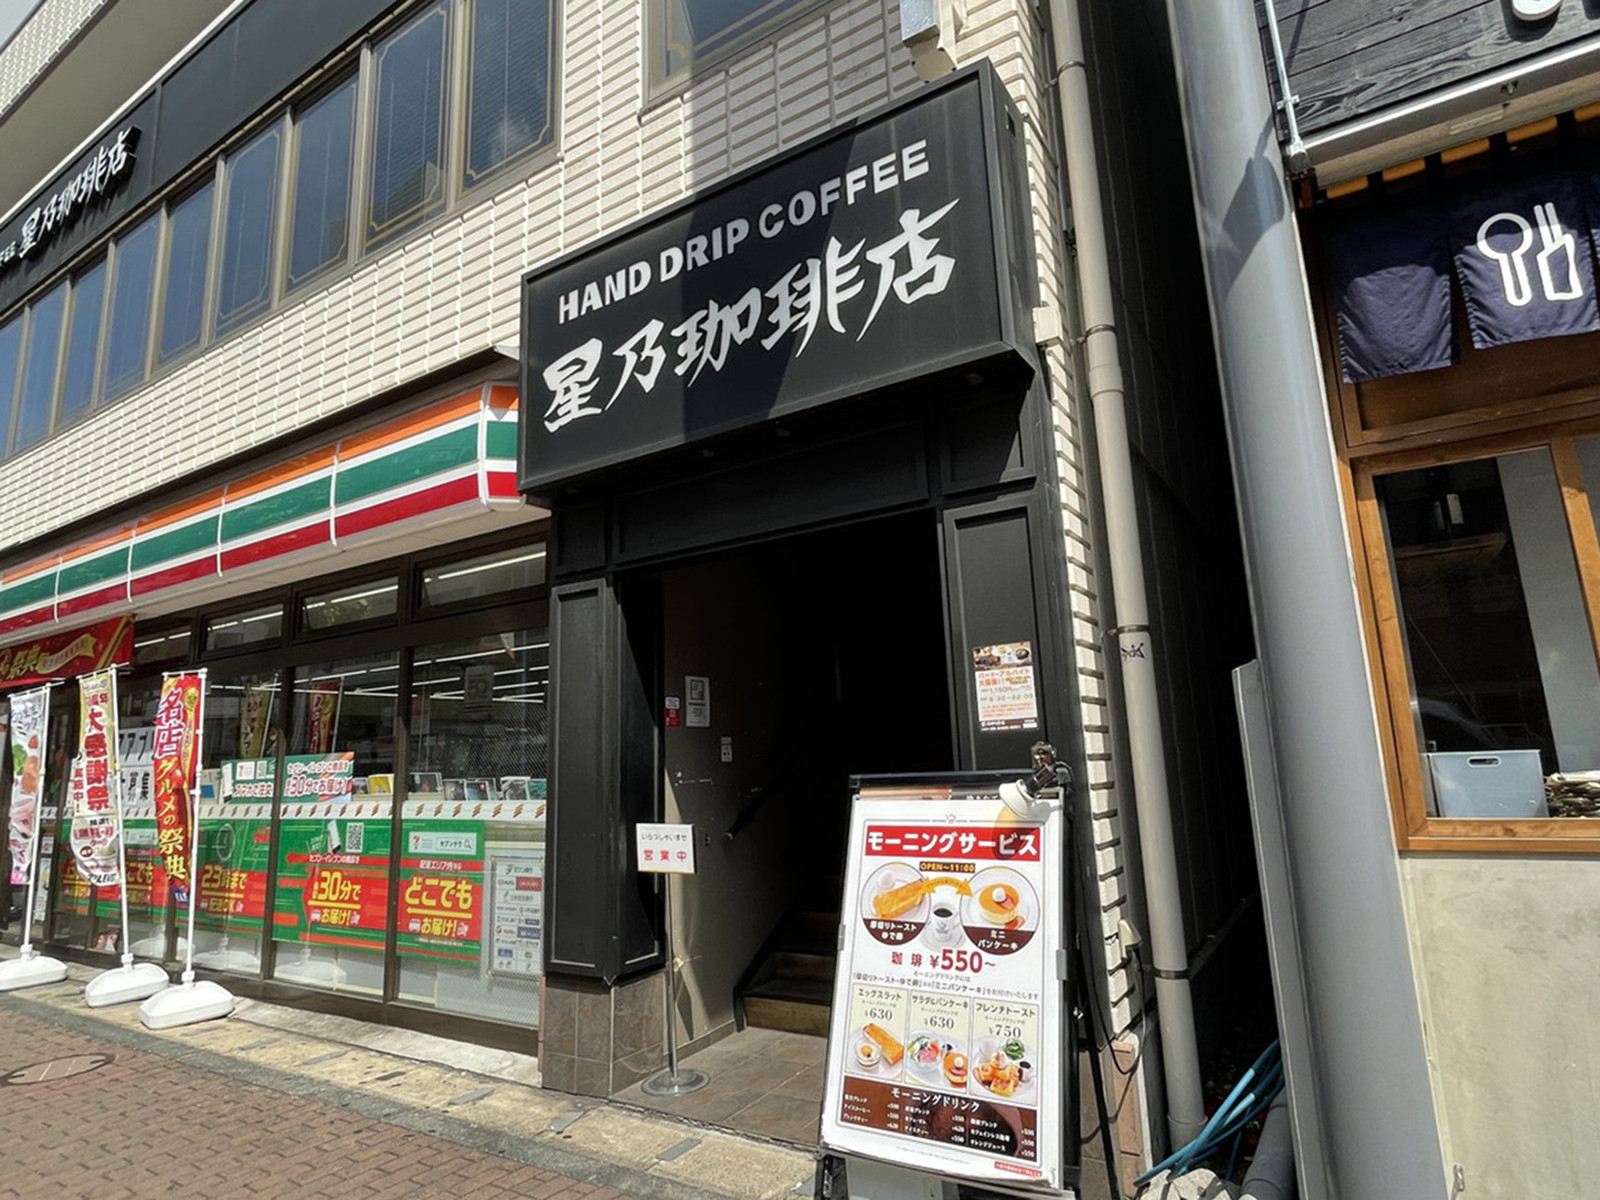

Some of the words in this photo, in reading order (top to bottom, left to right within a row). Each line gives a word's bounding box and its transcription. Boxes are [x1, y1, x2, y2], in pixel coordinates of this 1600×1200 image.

[19, 126, 132, 258] 星乃珈琲店
[558, 260, 651, 324] HAND
[659, 218, 749, 282] DRIP
[758, 139, 929, 239] COFFEE
[541, 198, 960, 433] 星乃珈琲店
[643, 849, 687, 862] 営業中
[867, 832, 1037, 856] モーニングサービス
[405, 876, 472, 910] どこでも
[978, 940, 1018, 950] パンケーキ
[976, 1002, 1035, 1018] フレンチトースト
[890, 1087, 980, 1112] モーニングドリンク
